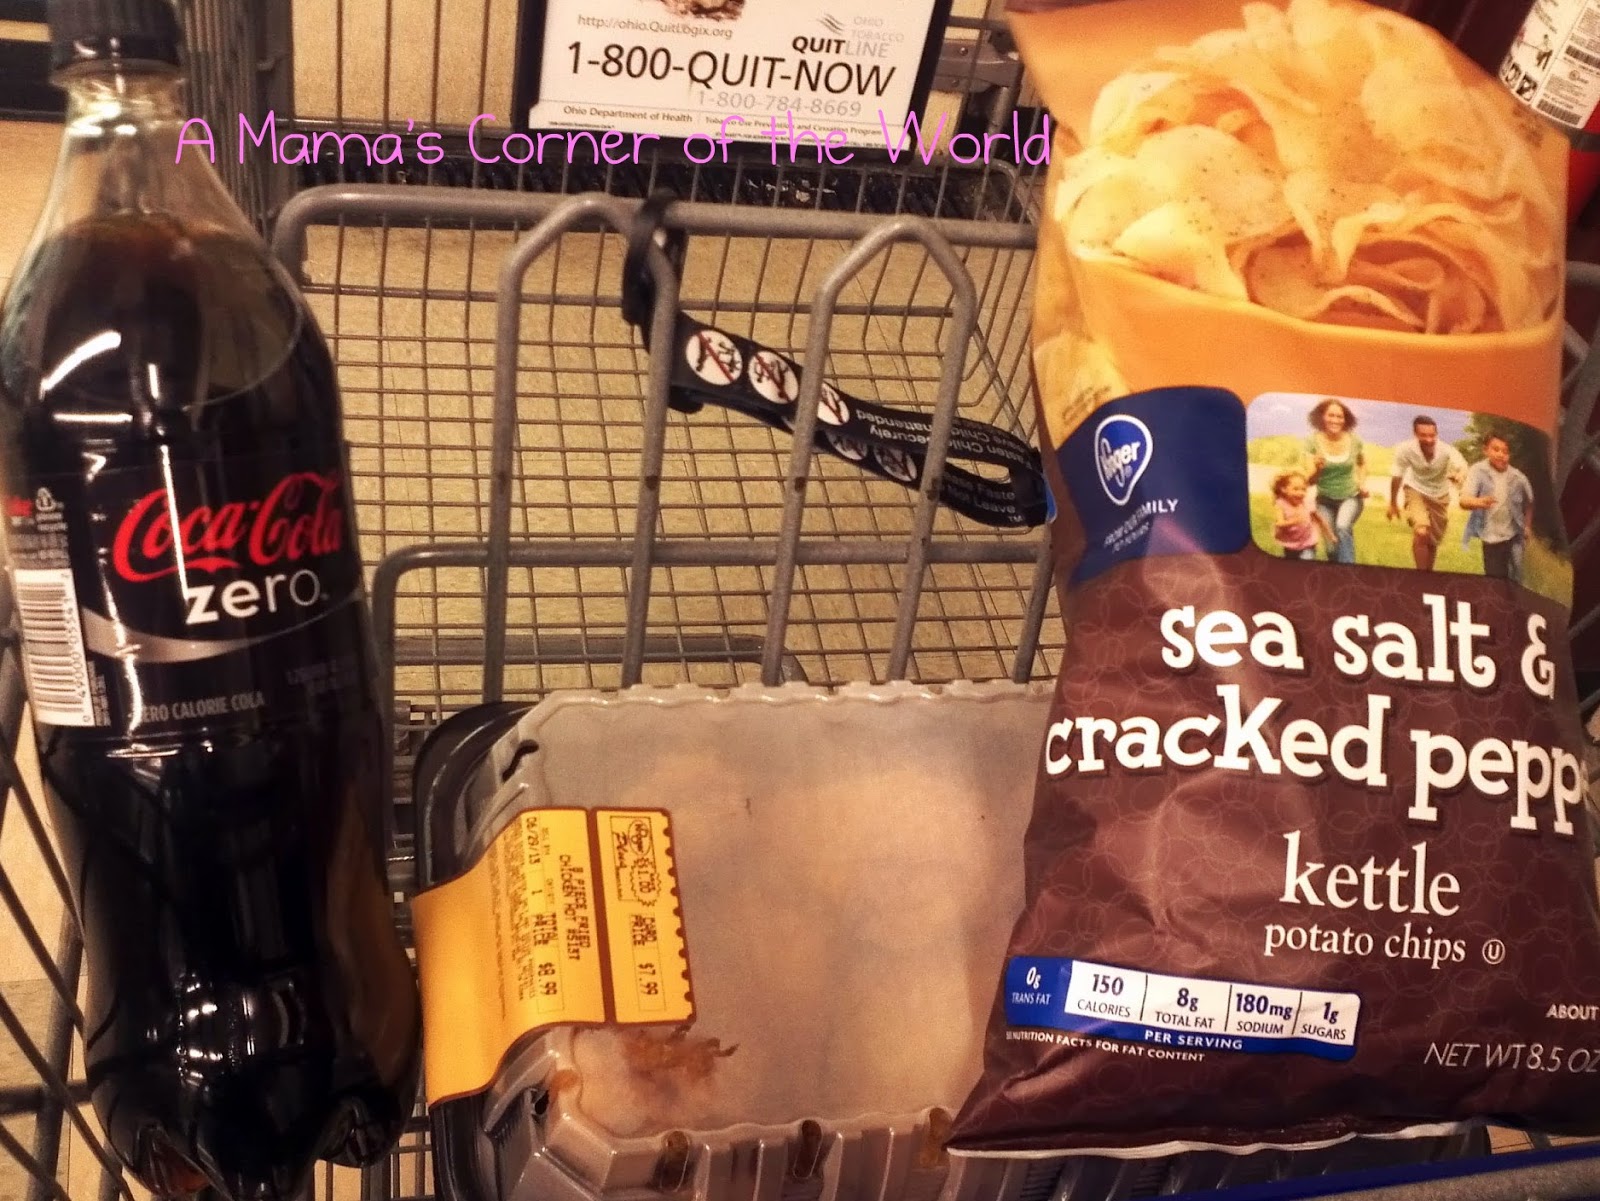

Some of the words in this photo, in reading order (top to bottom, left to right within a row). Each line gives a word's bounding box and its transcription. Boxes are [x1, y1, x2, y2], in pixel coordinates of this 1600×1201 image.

[567, 41, 896, 97] 1-800-QUIT-NOW
[563, 105, 587, 116] Ohio
[590, 107, 648, 120] Department
[650, 112, 660, 121] of
[662, 113, 693, 123] Health
[698, 90, 863, 117] 1-800-784-8669
[706, 116, 736, 126] Tobaco
[112, 472, 342, 582] Coca-Cola
[185, 569, 323, 625] zero
[1160, 604, 1304, 671] sea
[1331, 593, 1497, 688] salt
[1521, 613, 1556, 699] &
[136, 702, 170, 724] ERO
[172, 696, 228, 721] CALORIE
[230, 691, 266, 712] COLA
[1045, 684, 1391, 788] cracked
[1279, 830, 1461, 917] kettle
[576, 916, 590, 948] FRIED
[631, 914, 645, 946] PRICE
[1264, 920, 1375, 957] potato
[1385, 923, 1467, 970] chips
[537, 962, 557, 996] $8.99
[637, 962, 658, 995] $7.99
[1091, 973, 1124, 997] 150
[1077, 998, 1132, 1018] CALORIES
[1176, 987, 1199, 1012] 8g
[1235, 992, 1293, 1021] 180mg
[1322, 1002, 1339, 1024] 1g
[1545, 1003, 1600, 1021] ABOUT
[1154, 1011, 1192, 1028] TOTAL
[1193, 1016, 1216, 1030] FAT
[1236, 1020, 1285, 1035] SODIUM
[1301, 1023, 1348, 1041] SUGARS
[1013, 1031, 1054, 1043] NUTRITION
[1056, 1034, 1093, 1047] FACTS
[1095, 1040, 1121, 1054] FOR
[1122, 1044, 1145, 1057] FAT
[1147, 1048, 1206, 1062] CONTENT
[1144, 1029, 1173, 1043] PER
[1177, 1033, 1244, 1050] SERVING
[1424, 1041, 1481, 1067] NET
[1485, 1043, 1526, 1070] WT
[1526, 1043, 1565, 1072] 8.5
